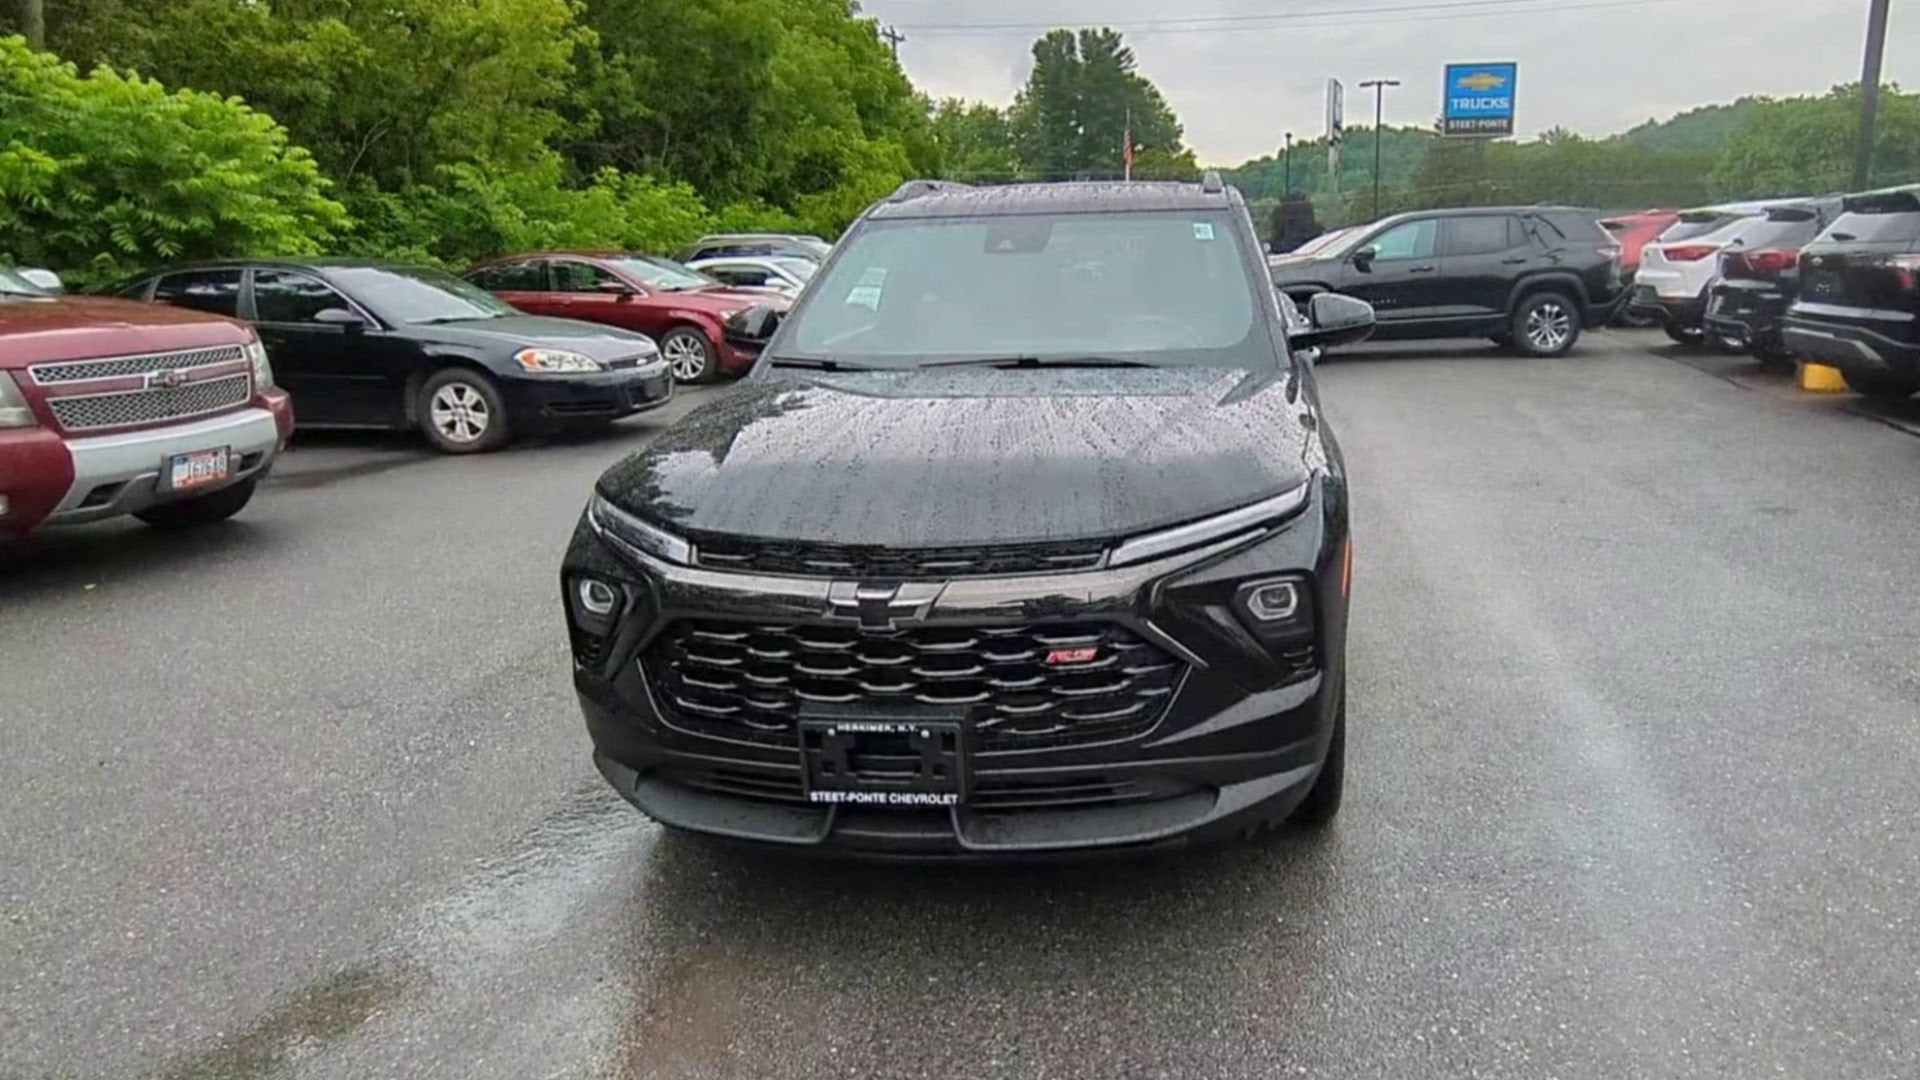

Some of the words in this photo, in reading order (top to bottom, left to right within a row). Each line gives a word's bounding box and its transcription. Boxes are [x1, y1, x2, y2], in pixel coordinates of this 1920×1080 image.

[1451, 97, 1509, 109] TRUCKS
[810, 791, 886, 802] STEET-PONTE
[889, 793, 957, 804] CHEVROLET
